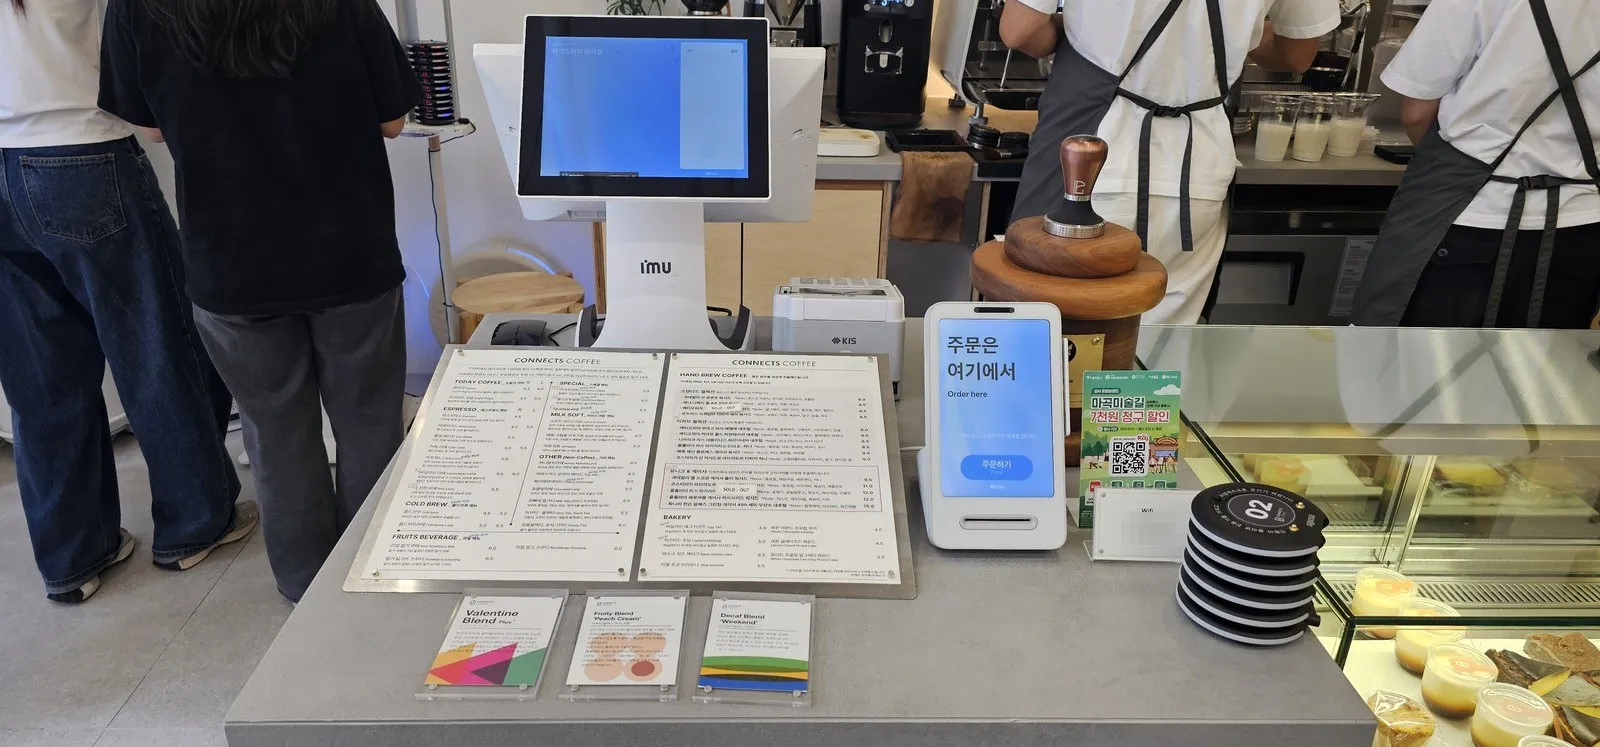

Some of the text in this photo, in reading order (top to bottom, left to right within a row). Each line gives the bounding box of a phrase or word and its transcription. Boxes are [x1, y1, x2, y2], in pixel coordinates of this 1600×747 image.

[947, 336, 998, 354] 주문은
[948, 362, 1016, 380] 여기에서
[1091, 397, 1144, 408] 마곡미술길
[1091, 411, 1169, 423] 7천원 청구 할인
[982, 460, 1012, 468] 주문하기
[1244, 499, 1273, 520] 02
